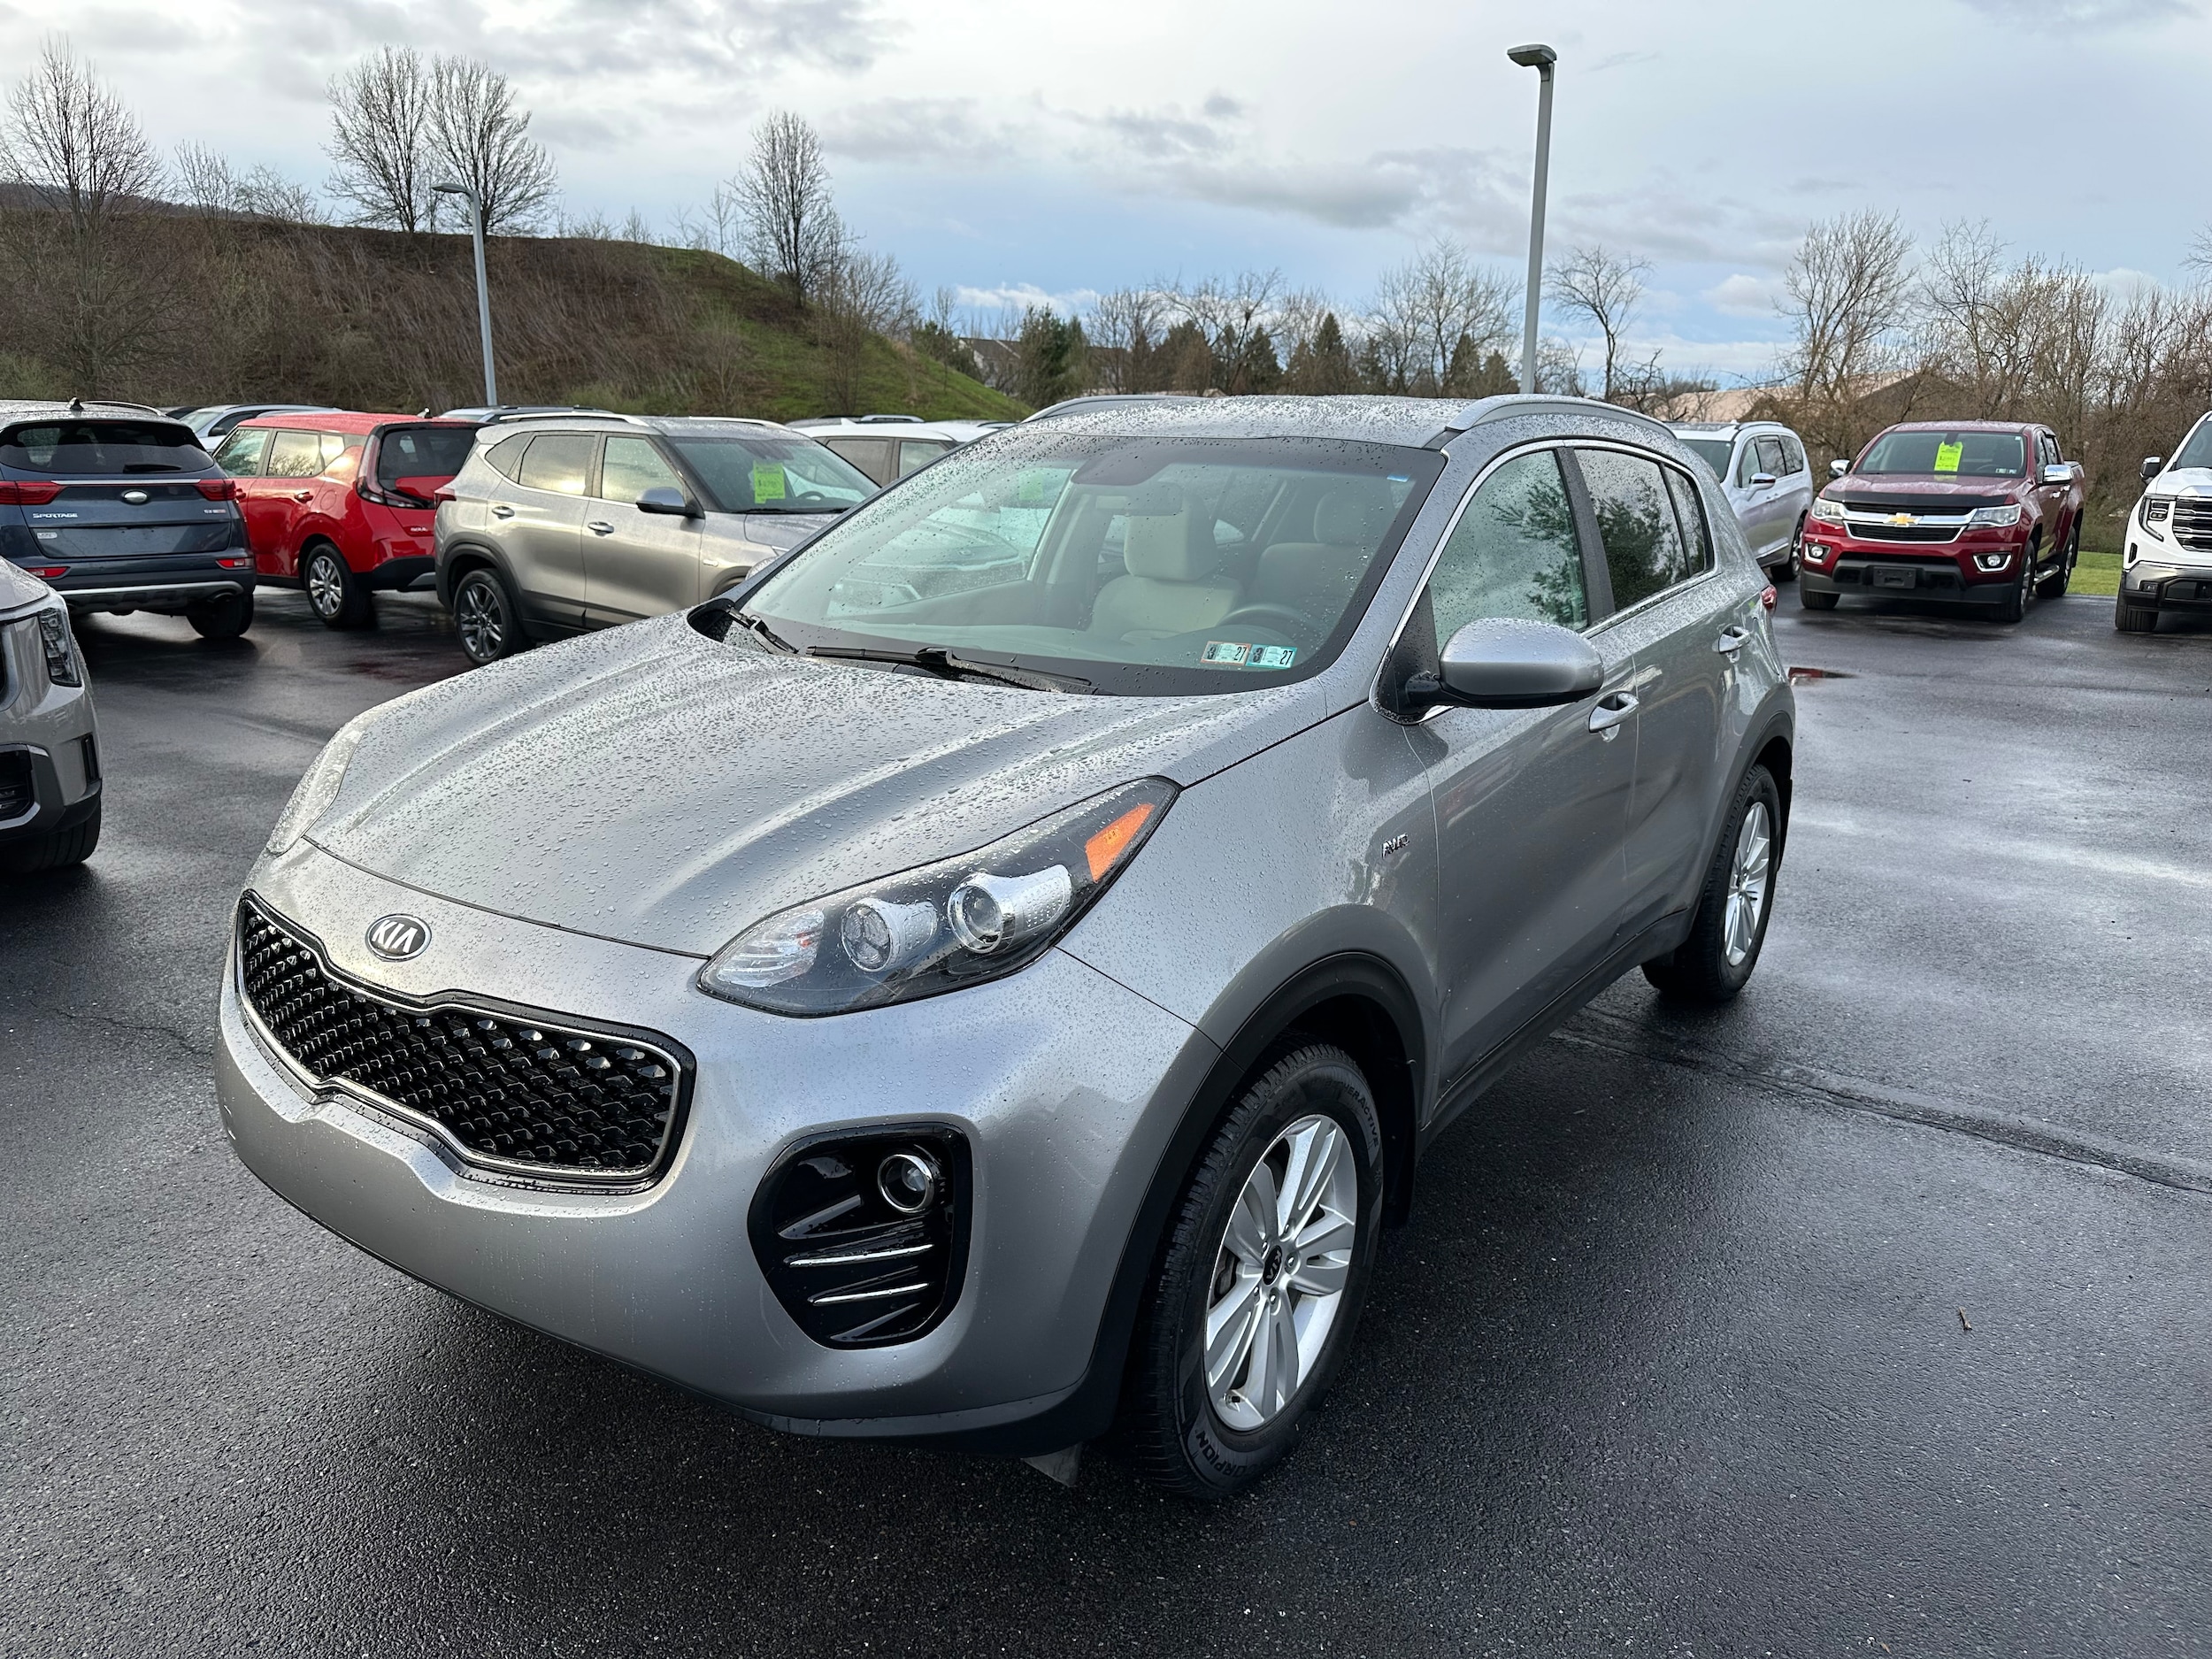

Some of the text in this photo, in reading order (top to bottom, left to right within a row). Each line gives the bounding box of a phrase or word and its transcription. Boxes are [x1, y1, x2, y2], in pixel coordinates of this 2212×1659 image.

[1233, 646, 1247, 662] 27
[1279, 649, 1293, 665] 27
[371, 919, 419, 954] KIA
[1265, 1249, 1282, 1279] KIA
